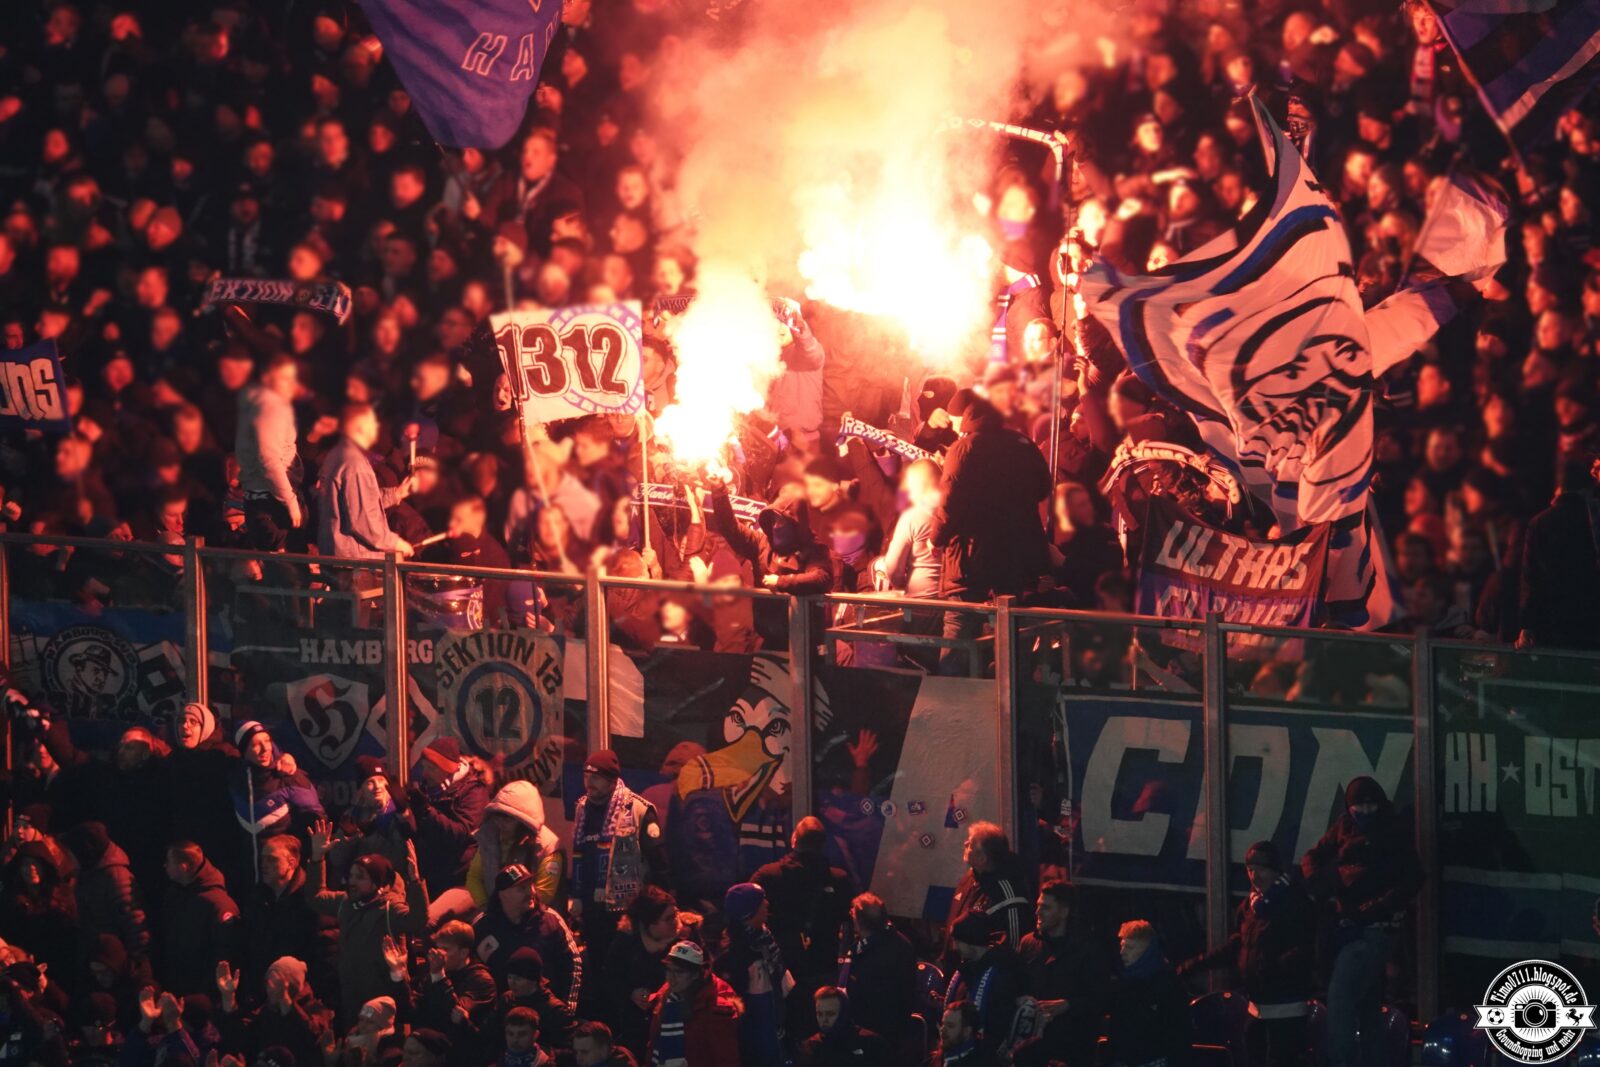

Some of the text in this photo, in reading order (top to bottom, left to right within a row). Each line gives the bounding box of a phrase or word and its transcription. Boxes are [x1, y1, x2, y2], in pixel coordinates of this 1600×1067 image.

[495, 323, 629, 401] 1312
[1155, 520, 1312, 591] ULTRAS
[300, 638, 434, 664] HAMBRG
[433, 631, 536, 689] SEKTION
[474, 685, 522, 740] 12
[1445, 731, 1499, 813] HH
